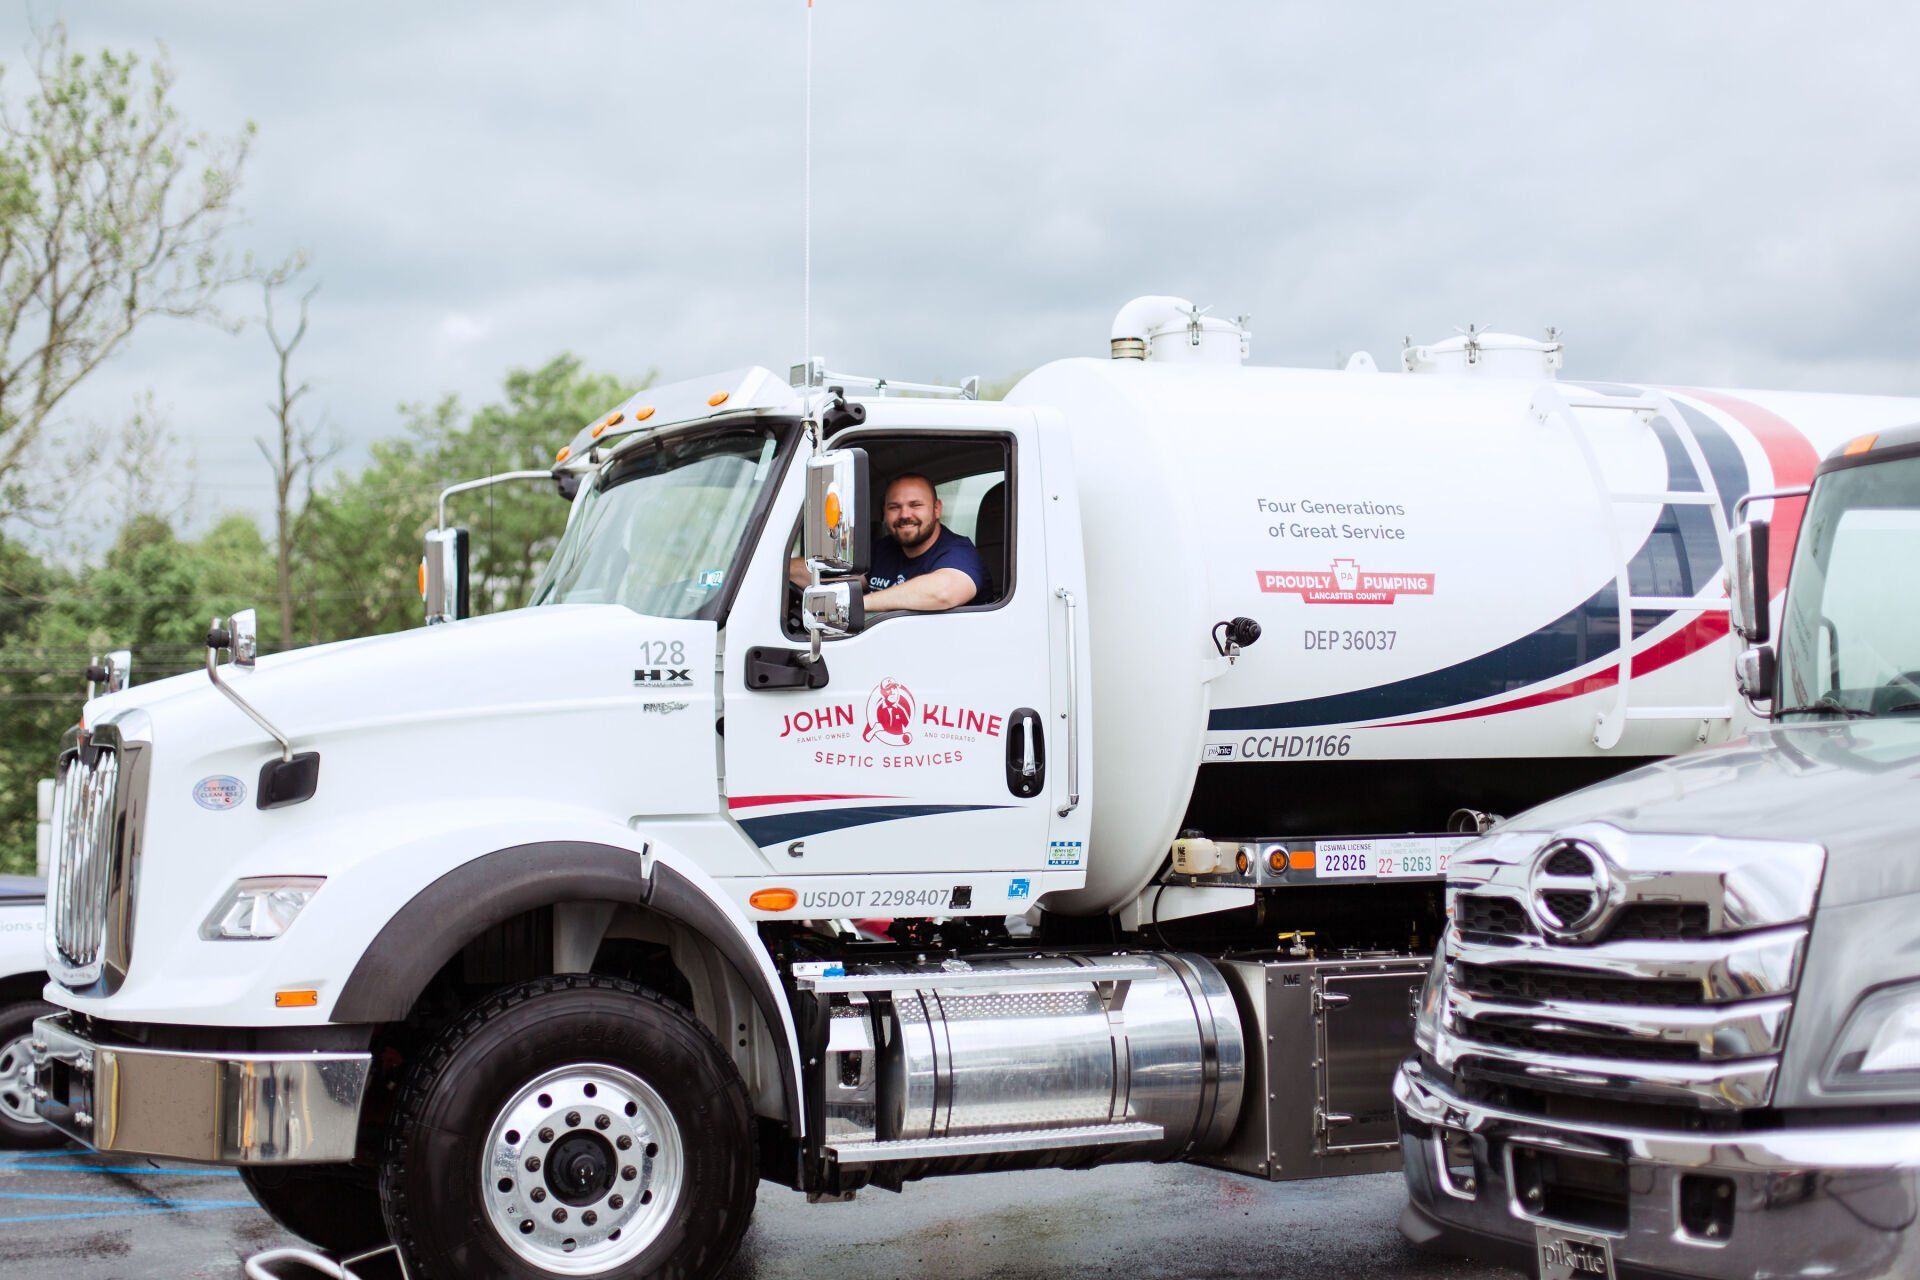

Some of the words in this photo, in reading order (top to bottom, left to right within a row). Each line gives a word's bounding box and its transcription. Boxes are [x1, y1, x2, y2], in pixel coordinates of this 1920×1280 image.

[1257, 498, 1297, 513] Four
[1300, 499, 1406, 517] Generations
[1268, 522, 1286, 539] of
[1289, 523, 1338, 540] Great
[1341, 524, 1406, 541] Service
[1265, 574, 1331, 590] PROUDLY
[1363, 577, 1428, 591] PUMPING
[1340, 572, 1354, 582] PA
[1309, 591, 1354, 601] LANCASTER
[1355, 592, 1387, 601] COUNTY
[1342, 630, 1397, 651] 36037
[639, 640, 686, 666] 128
[633, 669, 693, 681] HX
[779, 704, 854, 738] JOHN
[922, 703, 1003, 738] KLINE
[796, 734, 823, 744] FAMILY
[824, 731, 851, 741] OWNED
[923, 731, 938, 739] AND
[940, 732, 976, 743] OPERATED
[1241, 734, 1352, 759] CCHD1166
[814, 751, 874, 768] SEPTIC
[882, 750, 963, 768] SERVICES
[1319, 844, 1347, 852] LCSWMA
[1347, 843, 1373, 851] LICENSE
[1325, 854, 1367, 872] 22826
[1378, 856, 1432, 874] 22-6263
[802, 891, 865, 908] USDOT
[869, 889, 950, 908] 2298407
[1542, 1240, 1606, 1274] pikrite
